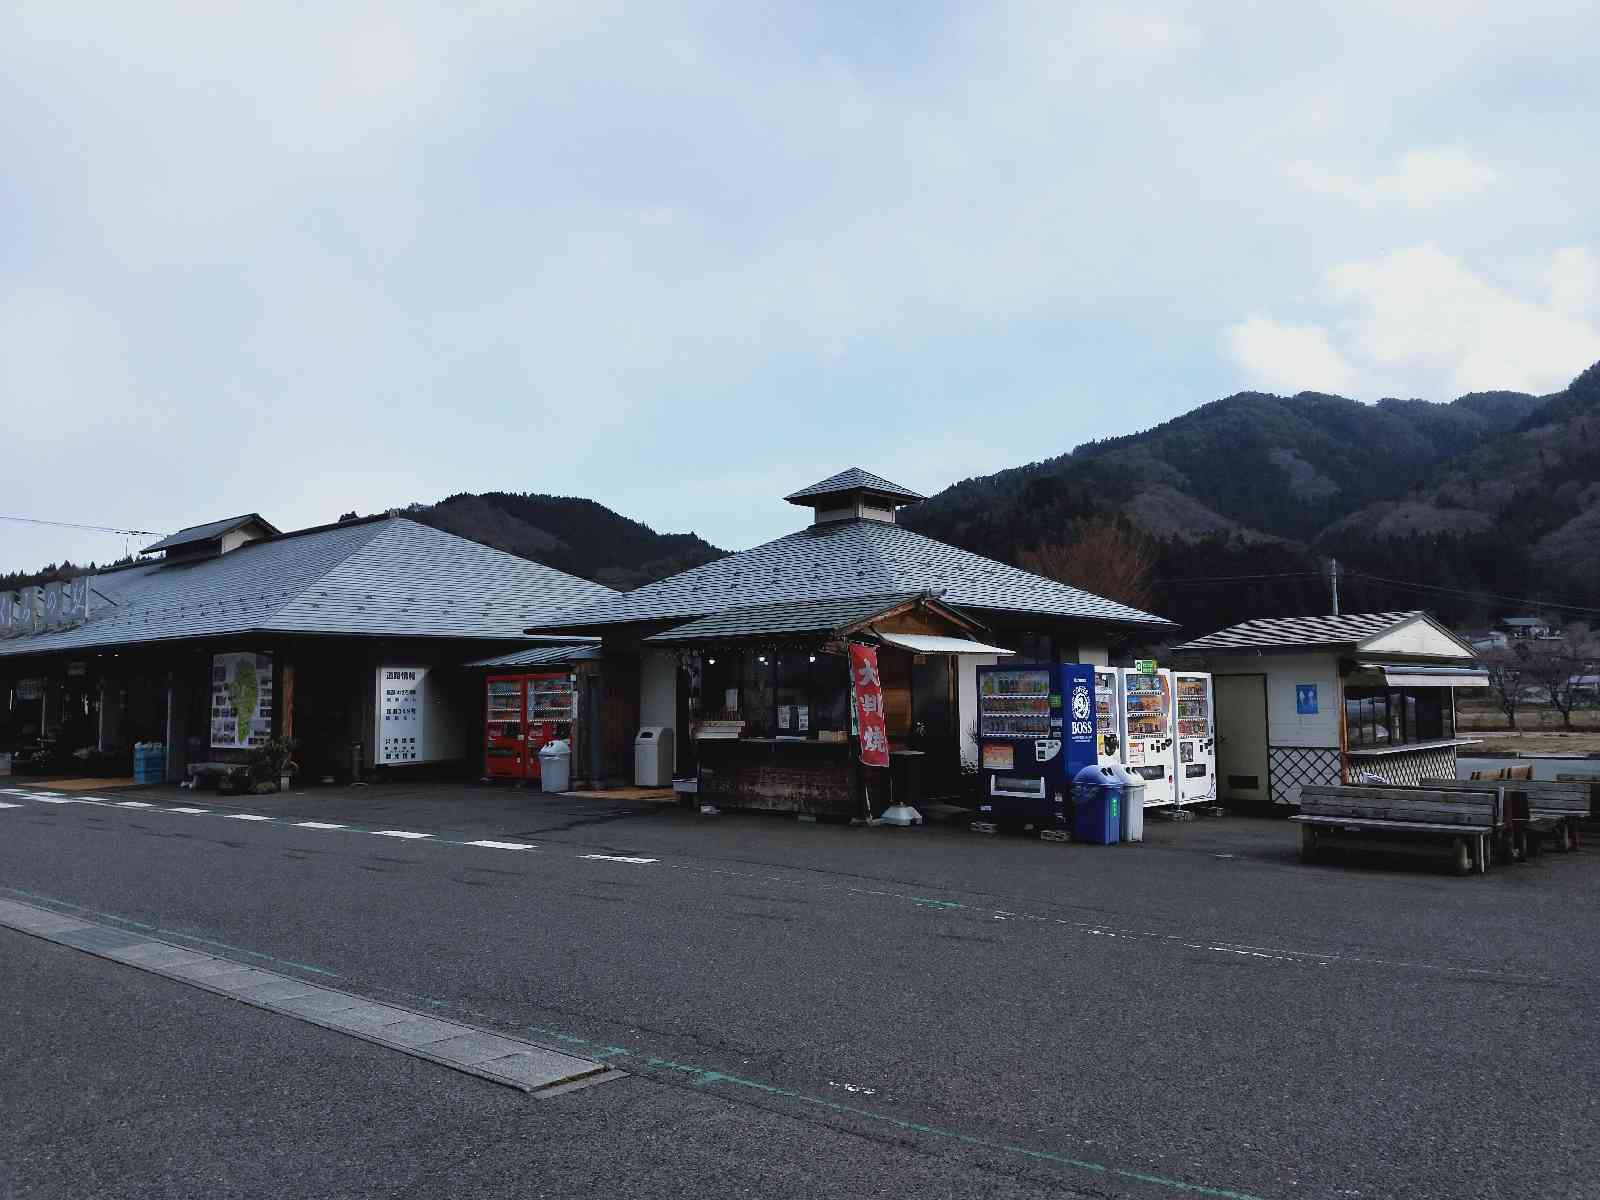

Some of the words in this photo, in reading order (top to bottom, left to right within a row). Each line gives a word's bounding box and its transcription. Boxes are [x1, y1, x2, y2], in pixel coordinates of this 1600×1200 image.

[386, 671, 416, 681] 道路情報
[1071, 720, 1093, 735] BOSS
